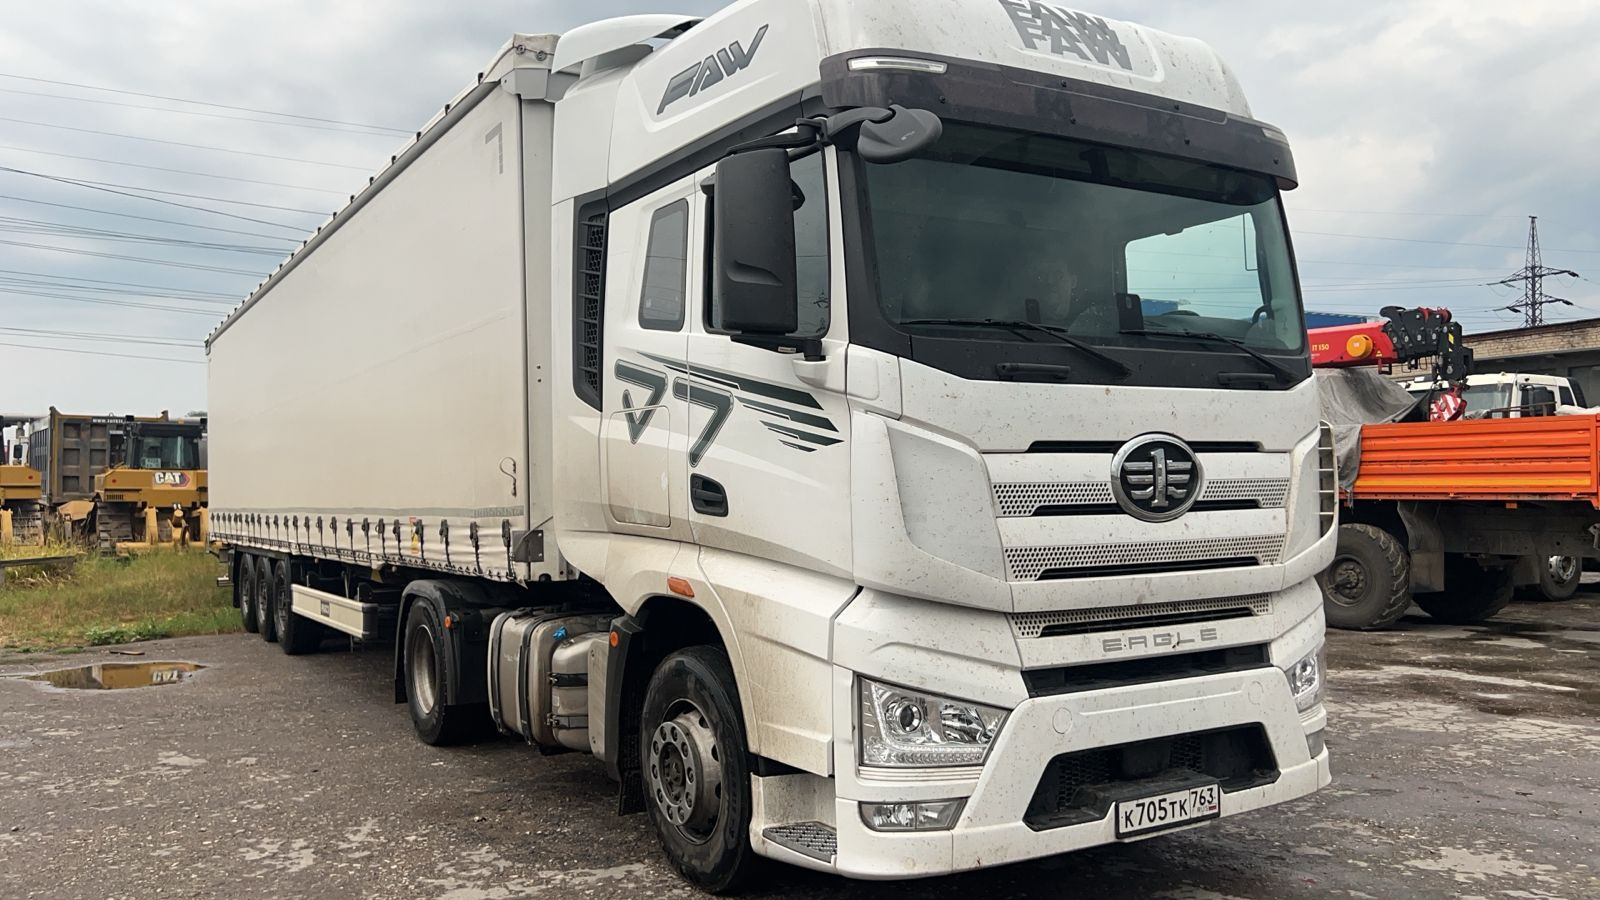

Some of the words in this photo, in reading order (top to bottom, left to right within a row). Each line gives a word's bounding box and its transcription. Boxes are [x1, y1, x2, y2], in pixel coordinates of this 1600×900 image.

[656, 23, 769, 115] FAW
[1318, 343, 1330, 351] 150
[154, 471, 181, 484] CAT
[1102, 627, 1218, 653] EAGLE
[1191, 787, 1214, 808] 763
